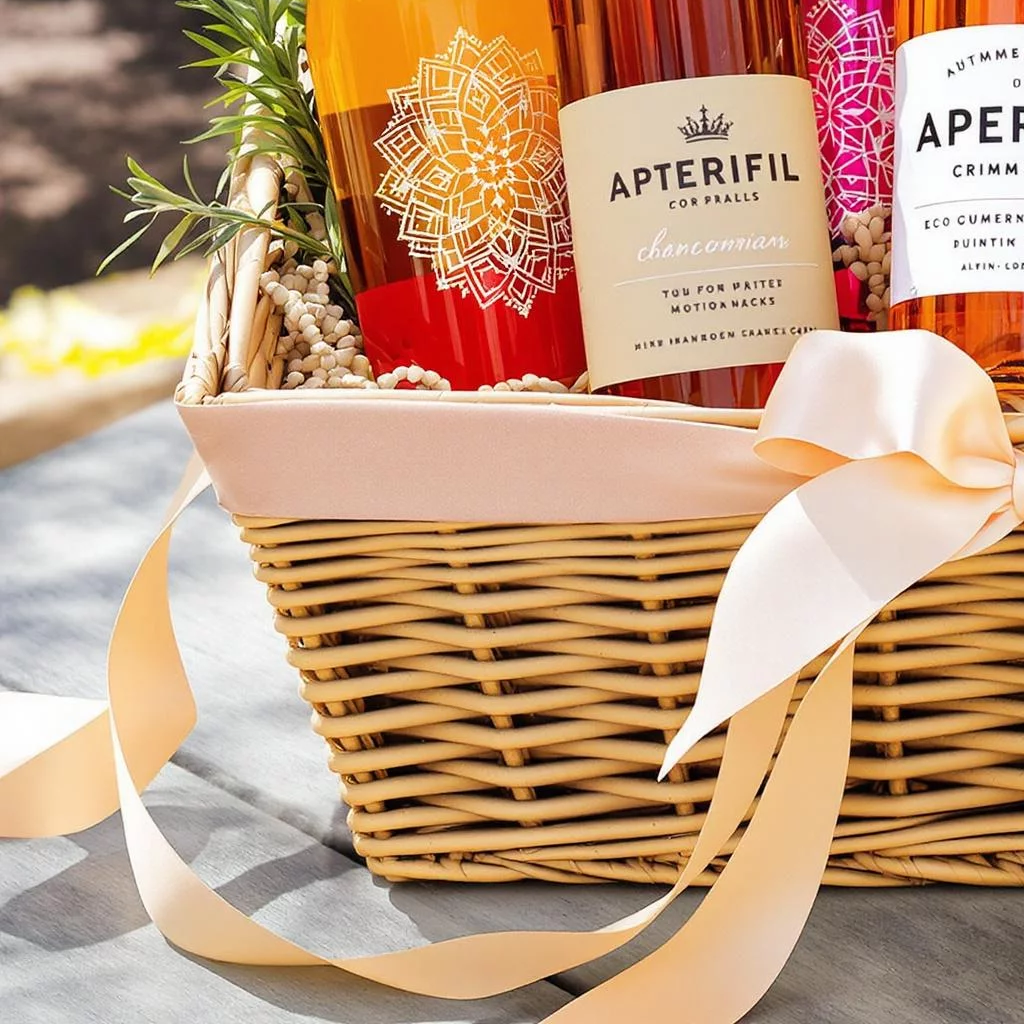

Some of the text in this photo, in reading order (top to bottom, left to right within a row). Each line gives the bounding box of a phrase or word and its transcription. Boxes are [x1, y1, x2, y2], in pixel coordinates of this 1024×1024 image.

[610, 153, 799, 202] APTERIFIL
[952, 163, 1018, 178] CRIMM
[924, 217, 950, 230] ECO
